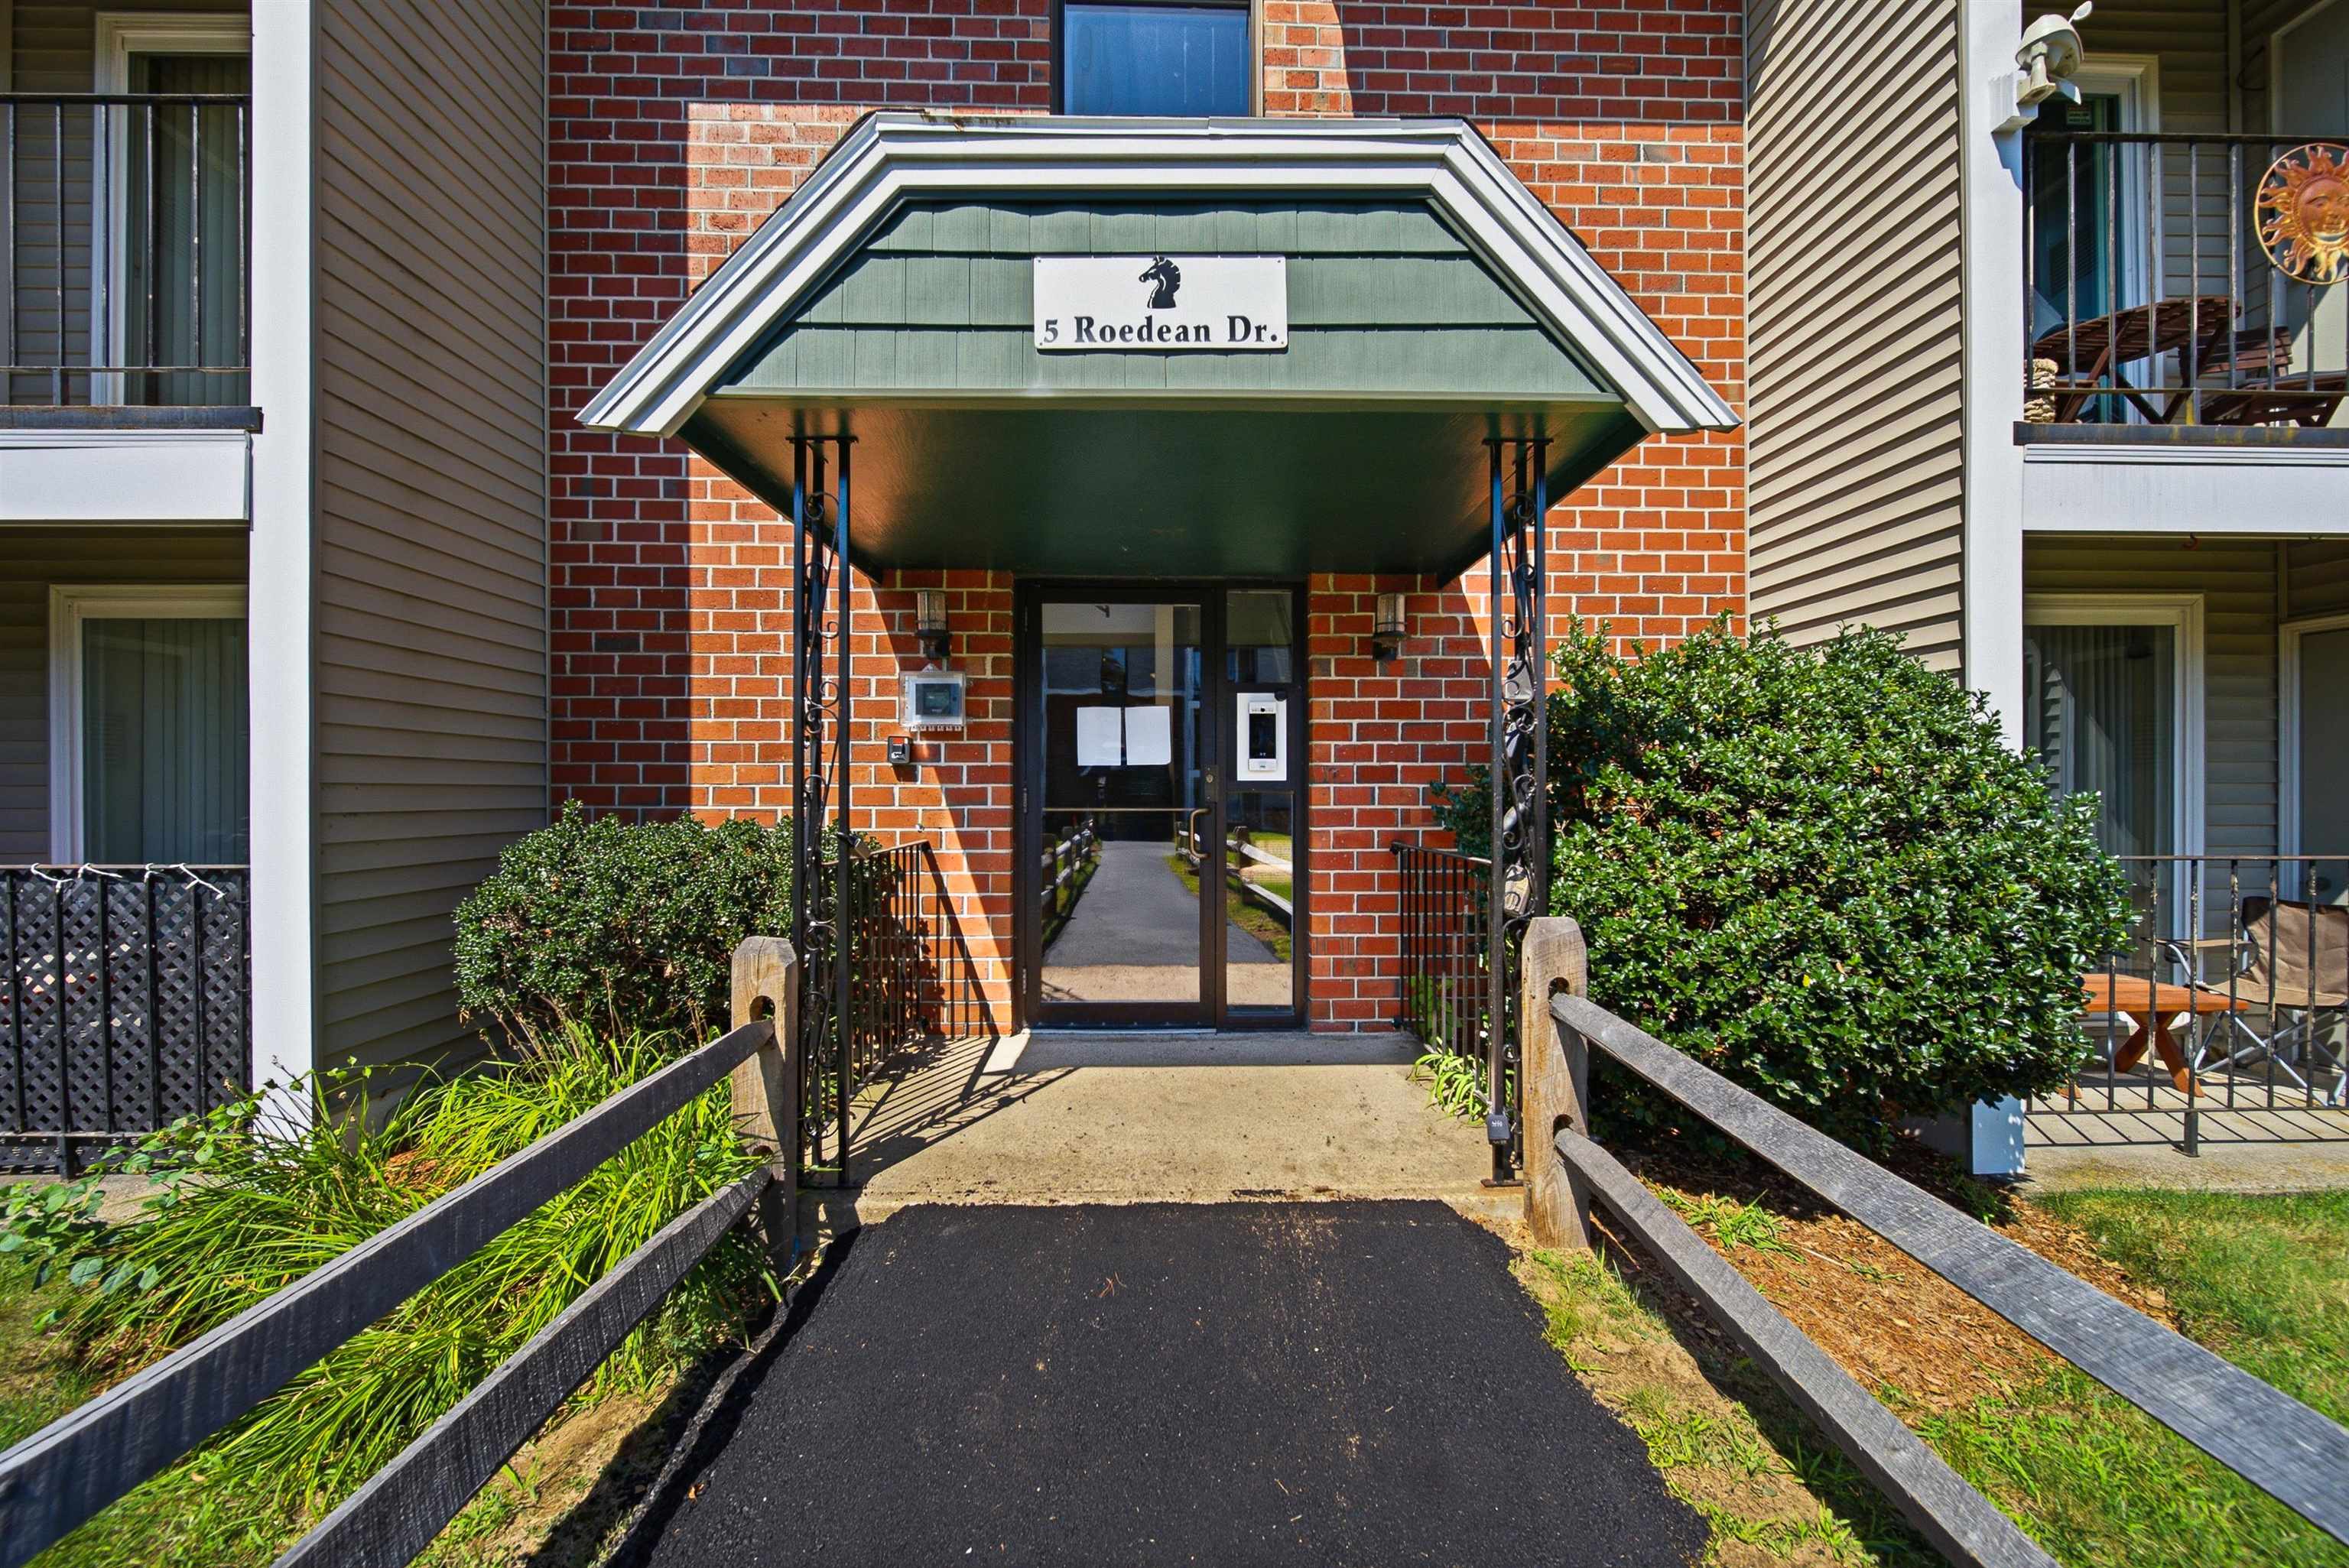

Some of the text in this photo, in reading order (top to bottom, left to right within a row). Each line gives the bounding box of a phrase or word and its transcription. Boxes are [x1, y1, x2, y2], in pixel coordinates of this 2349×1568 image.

[1044, 315, 1278, 342] 5 Roedean Dr.
